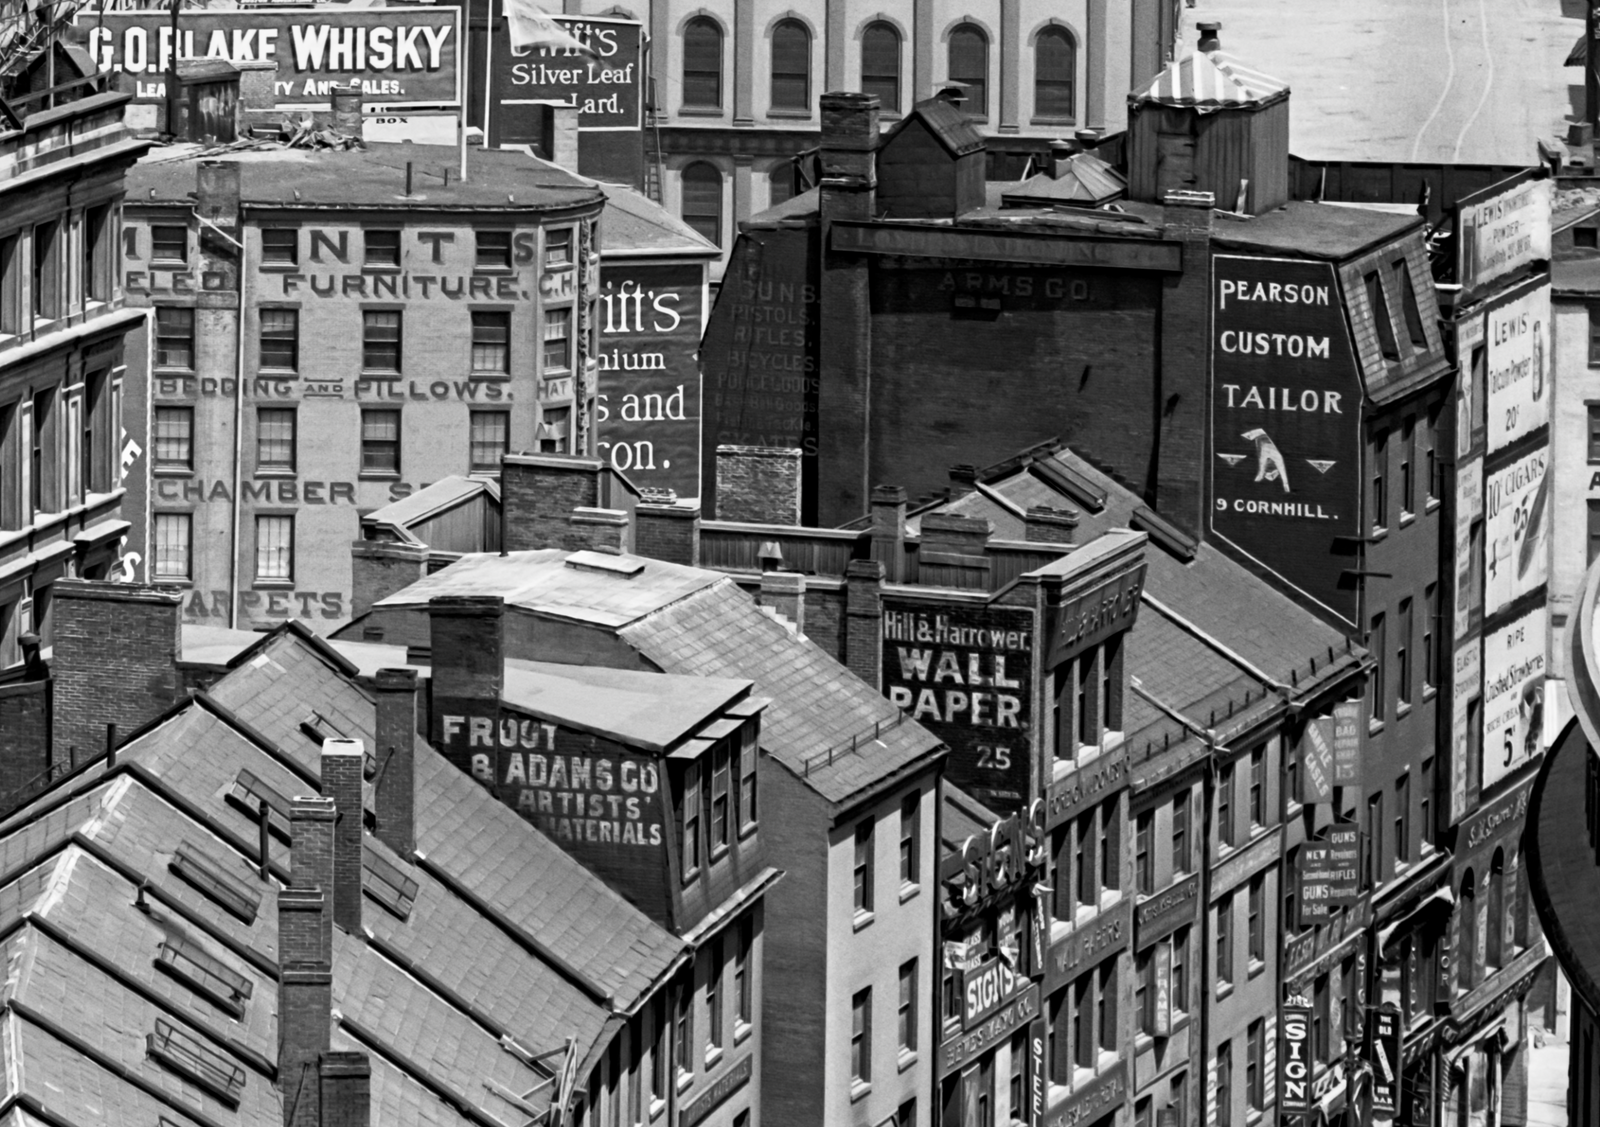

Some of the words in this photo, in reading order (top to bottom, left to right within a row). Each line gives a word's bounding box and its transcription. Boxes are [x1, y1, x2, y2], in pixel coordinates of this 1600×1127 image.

[290, 25, 452, 71] WHISKY
[512, 63, 583, 85] Silver
[586, 62, 634, 84] Leaf
[570, 93, 625, 114] Lard.
[599, 280, 681, 333] ift's
[1220, 279, 1329, 310] PEARSON
[1220, 330, 1330, 359] CUSTOM
[159, 379, 293, 398] BEDDING
[304, 383, 343, 394] AND
[1222, 384, 1343, 414] TAILOR
[621, 384, 686, 422] and
[1505, 452, 1546, 497] CIGARS
[157, 479, 357, 505] CHAMBER
[1216, 498, 1228, 511] 9
[1234, 499, 1339, 520] CORNHILL.
[1507, 626, 1526, 650] RIPE
[898, 646, 1020, 690] WALL
[505, 752, 614, 792] ADAMS
[1331, 831, 1356, 844] GUNS
[1305, 849, 1327, 860] NEW
[1330, 869, 1357, 881] RIFLES
[1302, 884, 1329, 900] GUNS
[1312, 904, 1328, 916] Sale
[967, 961, 1014, 1021] SIGNS
[1285, 1023, 1308, 1099] SIGN
